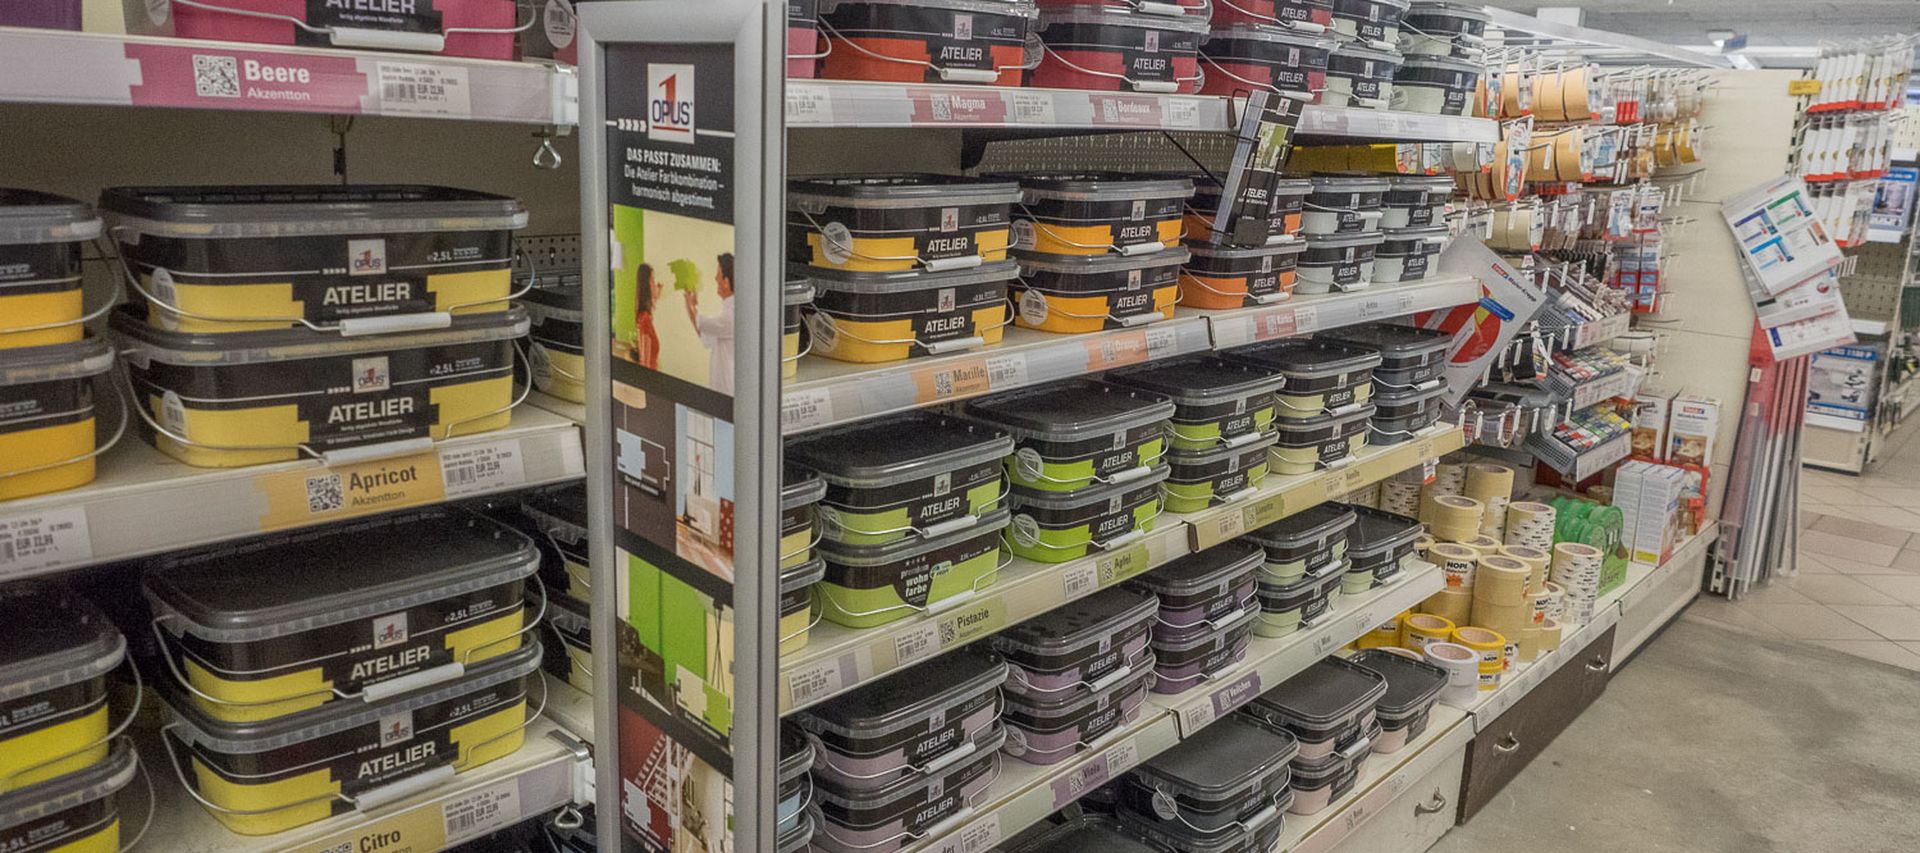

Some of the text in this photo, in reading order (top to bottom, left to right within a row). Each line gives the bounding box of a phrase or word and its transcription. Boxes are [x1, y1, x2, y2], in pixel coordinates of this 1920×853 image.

[1281, 7, 1308, 20] ATELIER
[940, 46, 982, 61] ATELIER
[244, 60, 310, 84] Beere
[1133, 57, 1166, 71] ATELIER
[1278, 70, 1304, 83] ATELIER
[247, 86, 310, 101] Akzentton
[651, 99, 691, 126] OPUS
[951, 95, 986, 112] Magma
[626, 147, 722, 173] DAS PASST ZUSAMMEN:
[624, 164, 636, 178] Die
[636, 165, 659, 182] Atelier
[659, 169, 718, 191] Farbkombination
[631, 183, 671, 201] harmonisch
[1120, 225, 1151, 239] ATELIER
[927, 237, 968, 253] ATELIER
[1253, 276, 1276, 288] ATELIER
[323, 283, 411, 306] ATELIER
[1116, 294, 1148, 309] ATELIER
[925, 316, 965, 333] ATELIER
[1329, 391, 1350, 404] ATELIER
[328, 396, 414, 424] ATELIER
[1225, 416, 1250, 433] ATELIER
[1324, 441, 1345, 455] ATELIER
[1102, 450, 1133, 469] ATELIER
[350, 465, 418, 492] Apricot
[1219, 474, 1244, 490] ATELIER
[351, 489, 406, 507] Akzentton
[919, 496, 960, 519] ATELIER
[1098, 513, 1129, 533] ATELIER
[1446, 562, 1468, 570] NOPI
[906, 572, 929, 587] wohn
[905, 584, 928, 598] farbe
[1210, 595, 1234, 612] ATELIER
[956, 608, 990, 629] Pistazie
[350, 644, 430, 680] ATELIER
[1087, 652, 1118, 673] ATELIER
[1087, 707, 1116, 731] ATELIER
[916, 728, 955, 755] ATELIER
[357, 740, 436, 779] ATELIER
[915, 797, 954, 825] ATELIER
[359, 830, 401, 853] Citro
